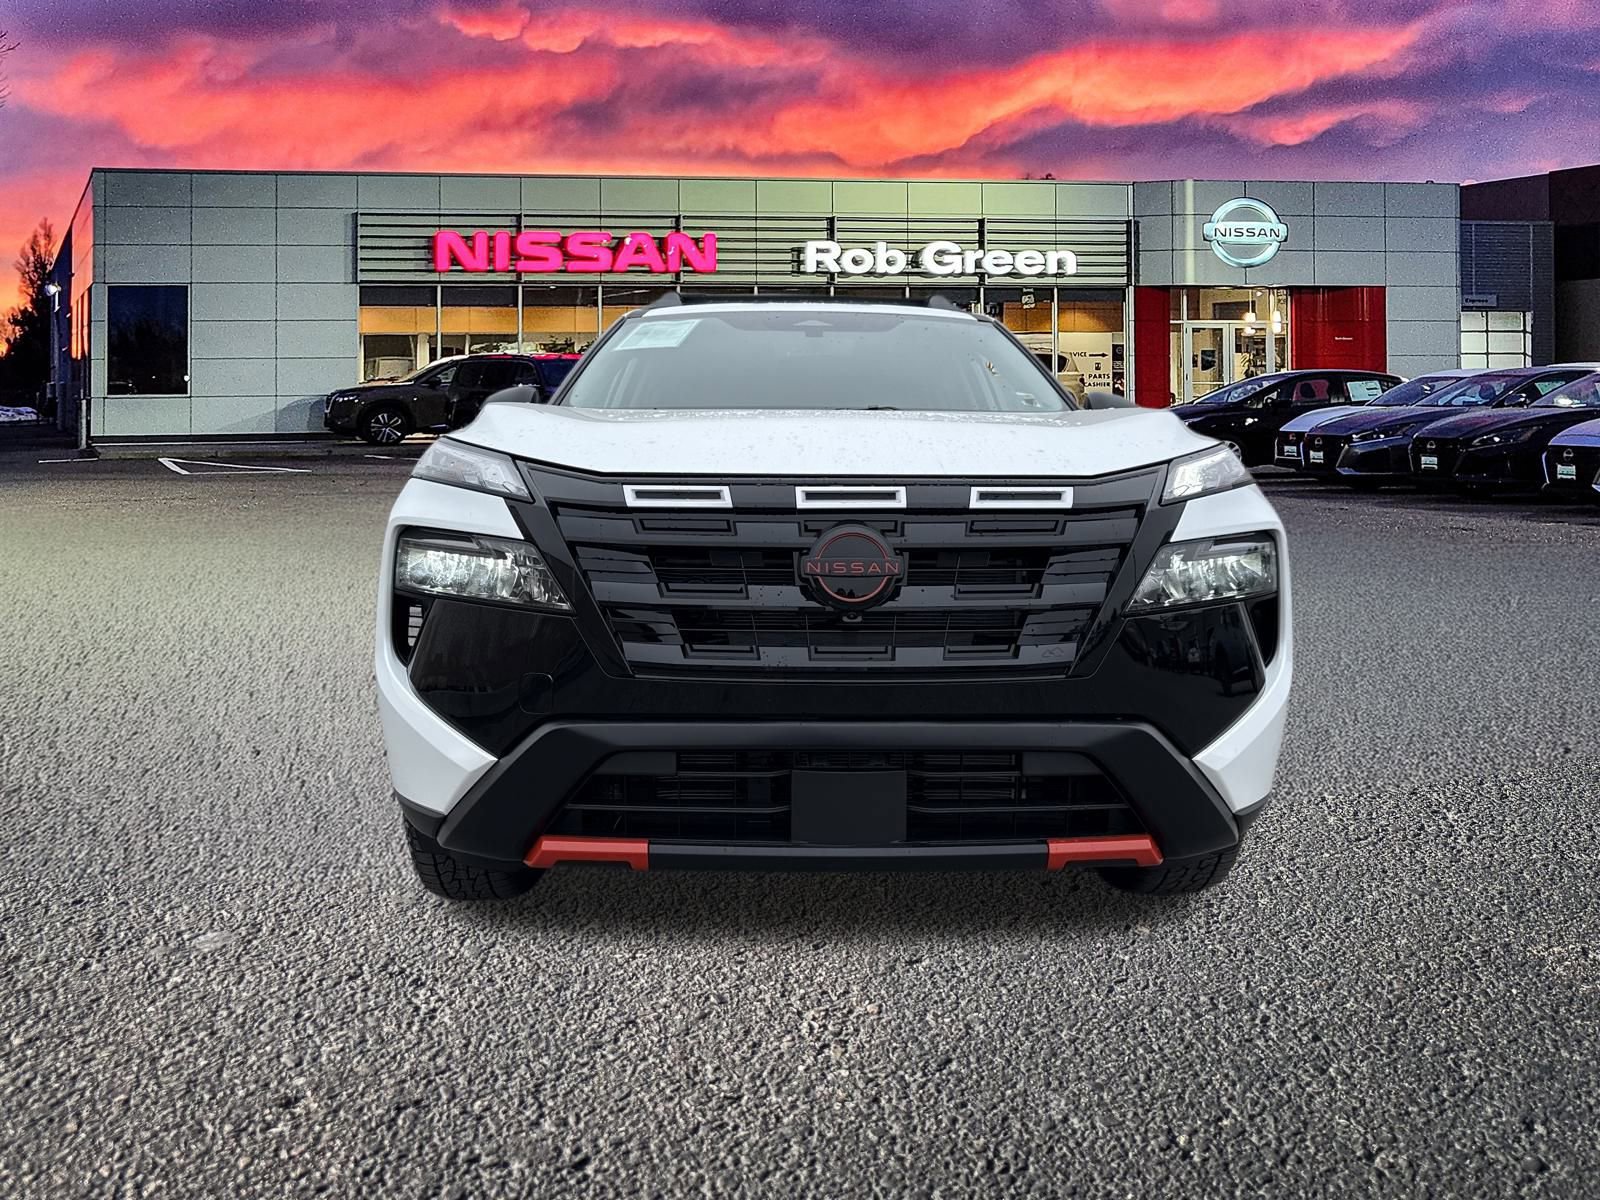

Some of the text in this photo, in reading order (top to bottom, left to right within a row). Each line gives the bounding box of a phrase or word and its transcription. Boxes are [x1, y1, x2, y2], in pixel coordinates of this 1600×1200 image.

[1214, 227, 1280, 238] NISSAN
[434, 230, 718, 273] NISSAN
[804, 240, 1078, 275] Rob Green
[806, 561, 900, 574] NISSAN
